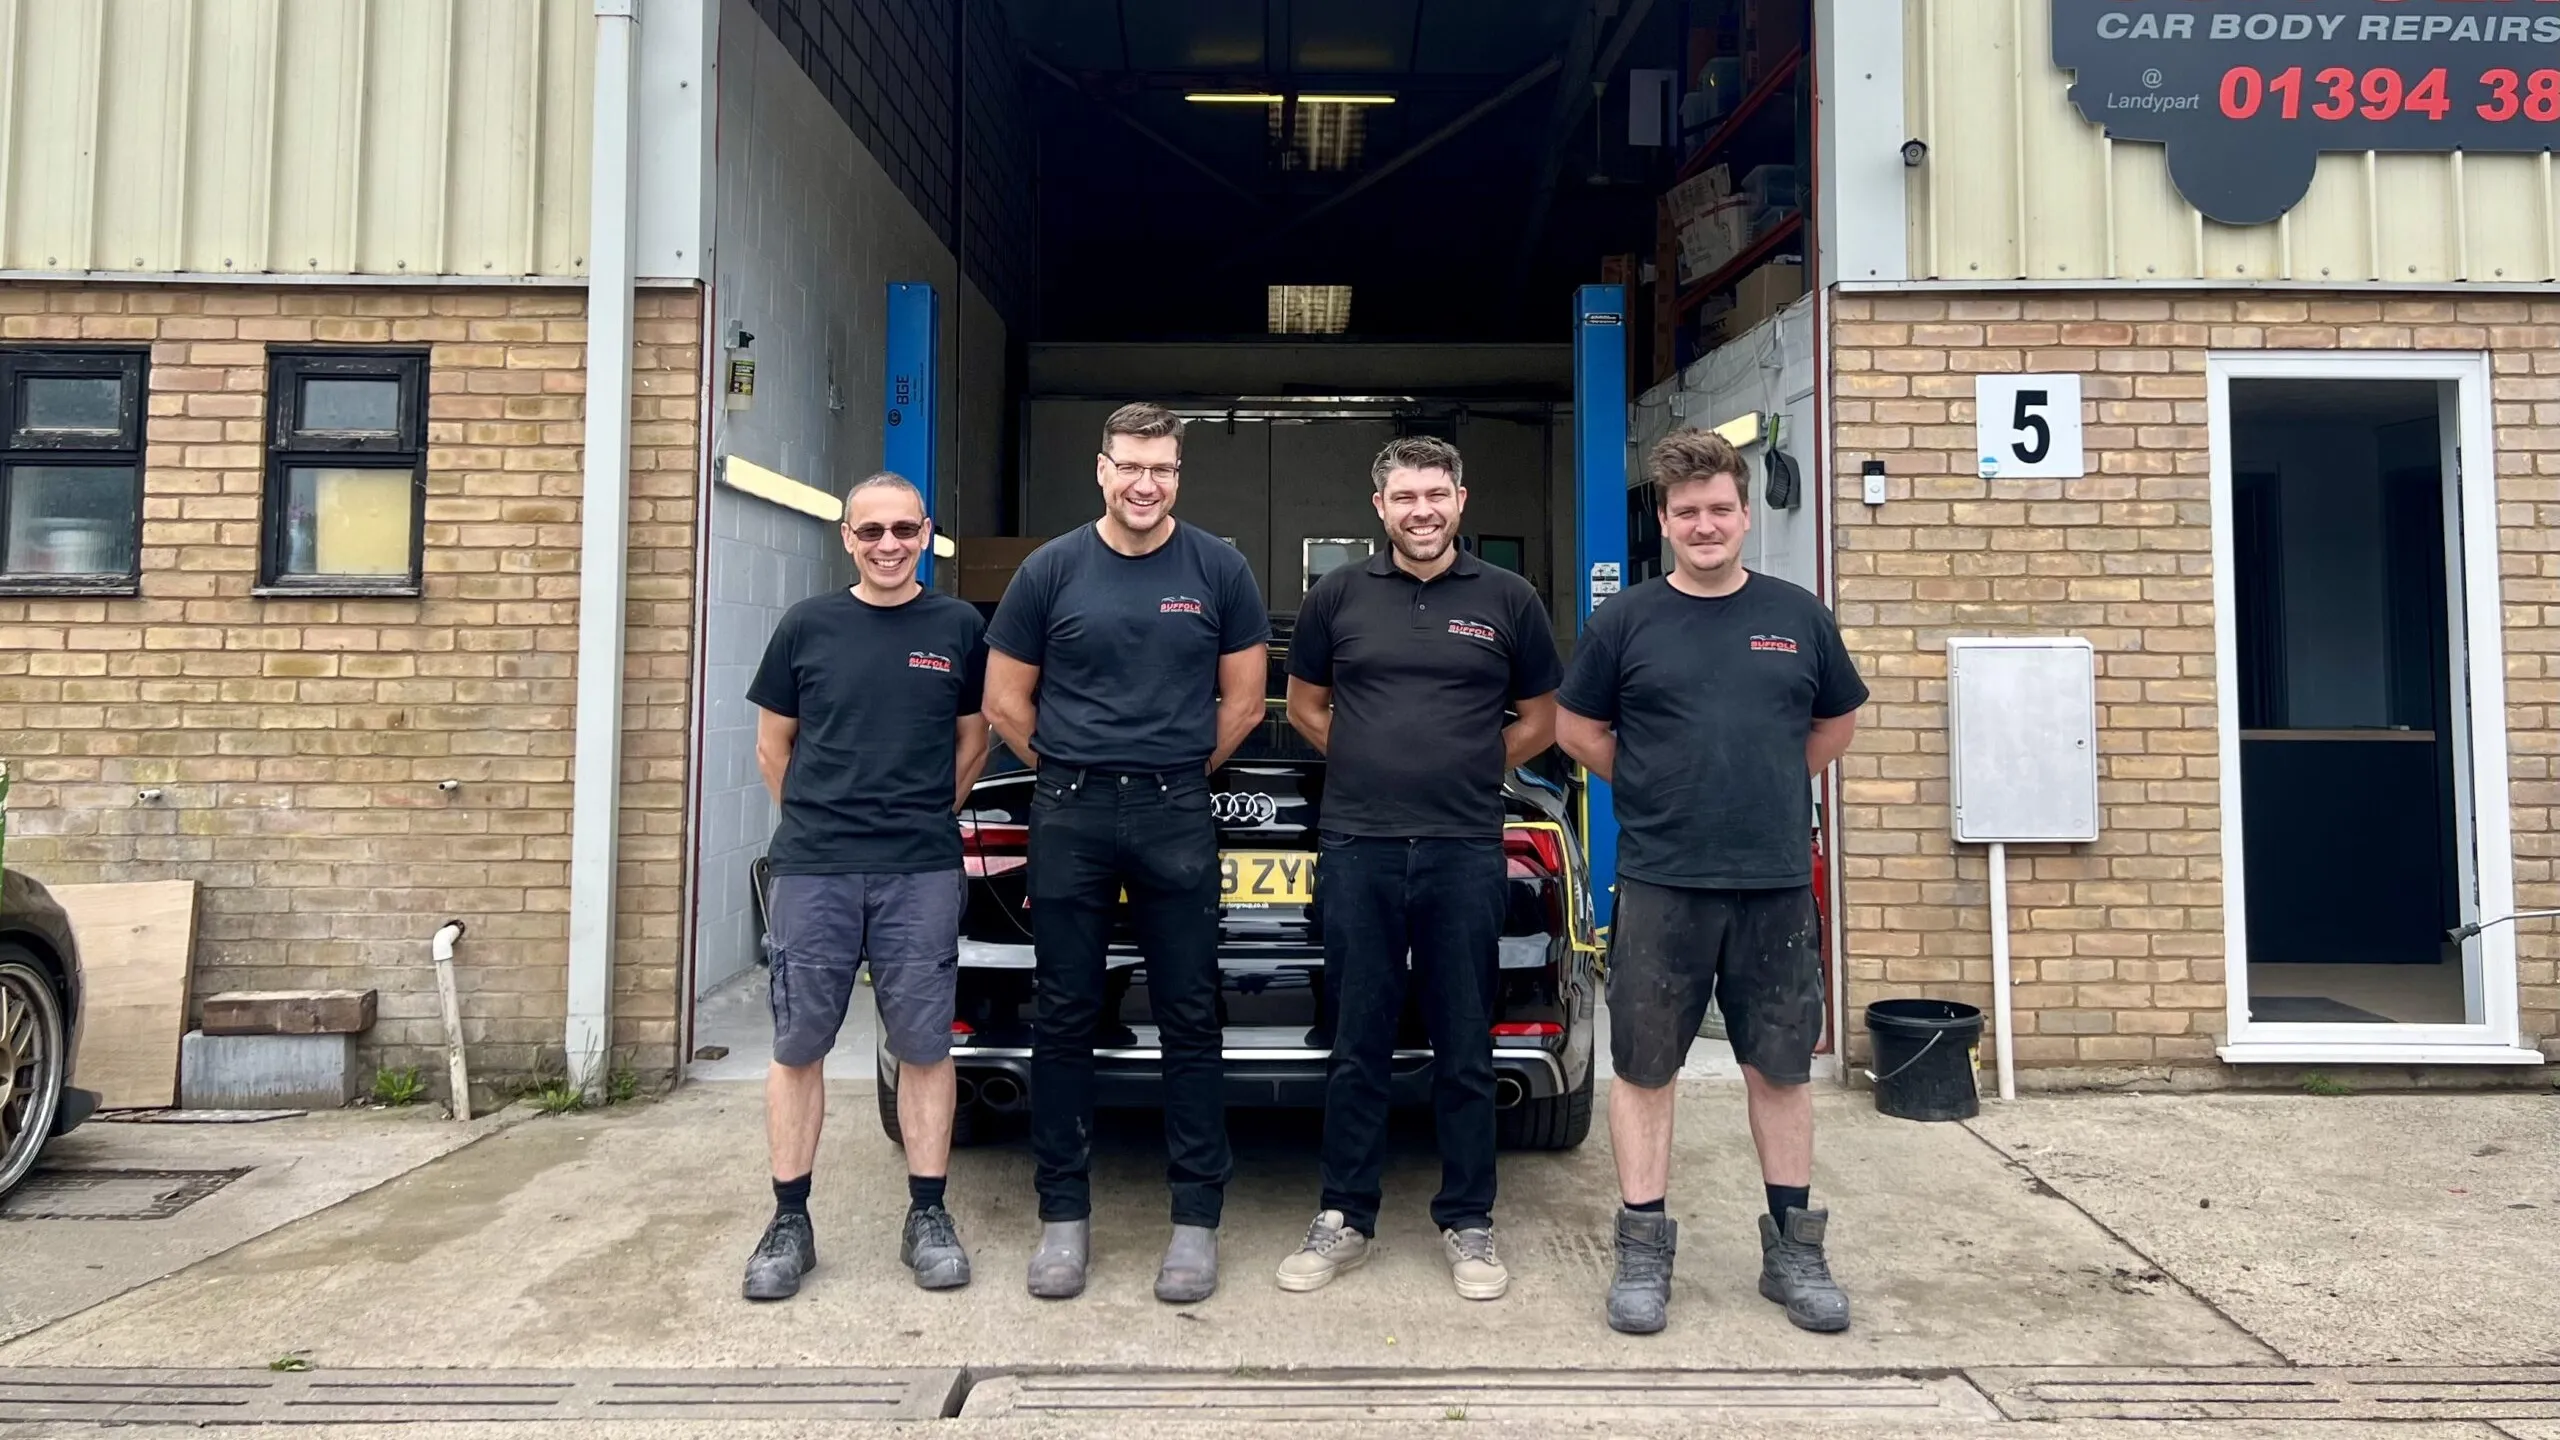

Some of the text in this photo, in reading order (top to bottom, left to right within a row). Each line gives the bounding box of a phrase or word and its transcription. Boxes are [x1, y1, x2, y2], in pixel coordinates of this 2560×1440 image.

[2096, 12, 2560, 43] CAR BODY REPAIRS
[2141, 67, 2163, 90] @
[2107, 92, 2199, 115] Landypart
[2218, 66, 2560, 122] 01394 38
[896, 374, 910, 405] BGE
[2011, 389, 2051, 464] 5
[1160, 602, 1201, 611] SUFFOLK
[1449, 624, 1495, 637] SUFFOLK
[1750, 640, 1798, 650] SUFFOLK
[909, 656, 951, 669] SUFFOLK
